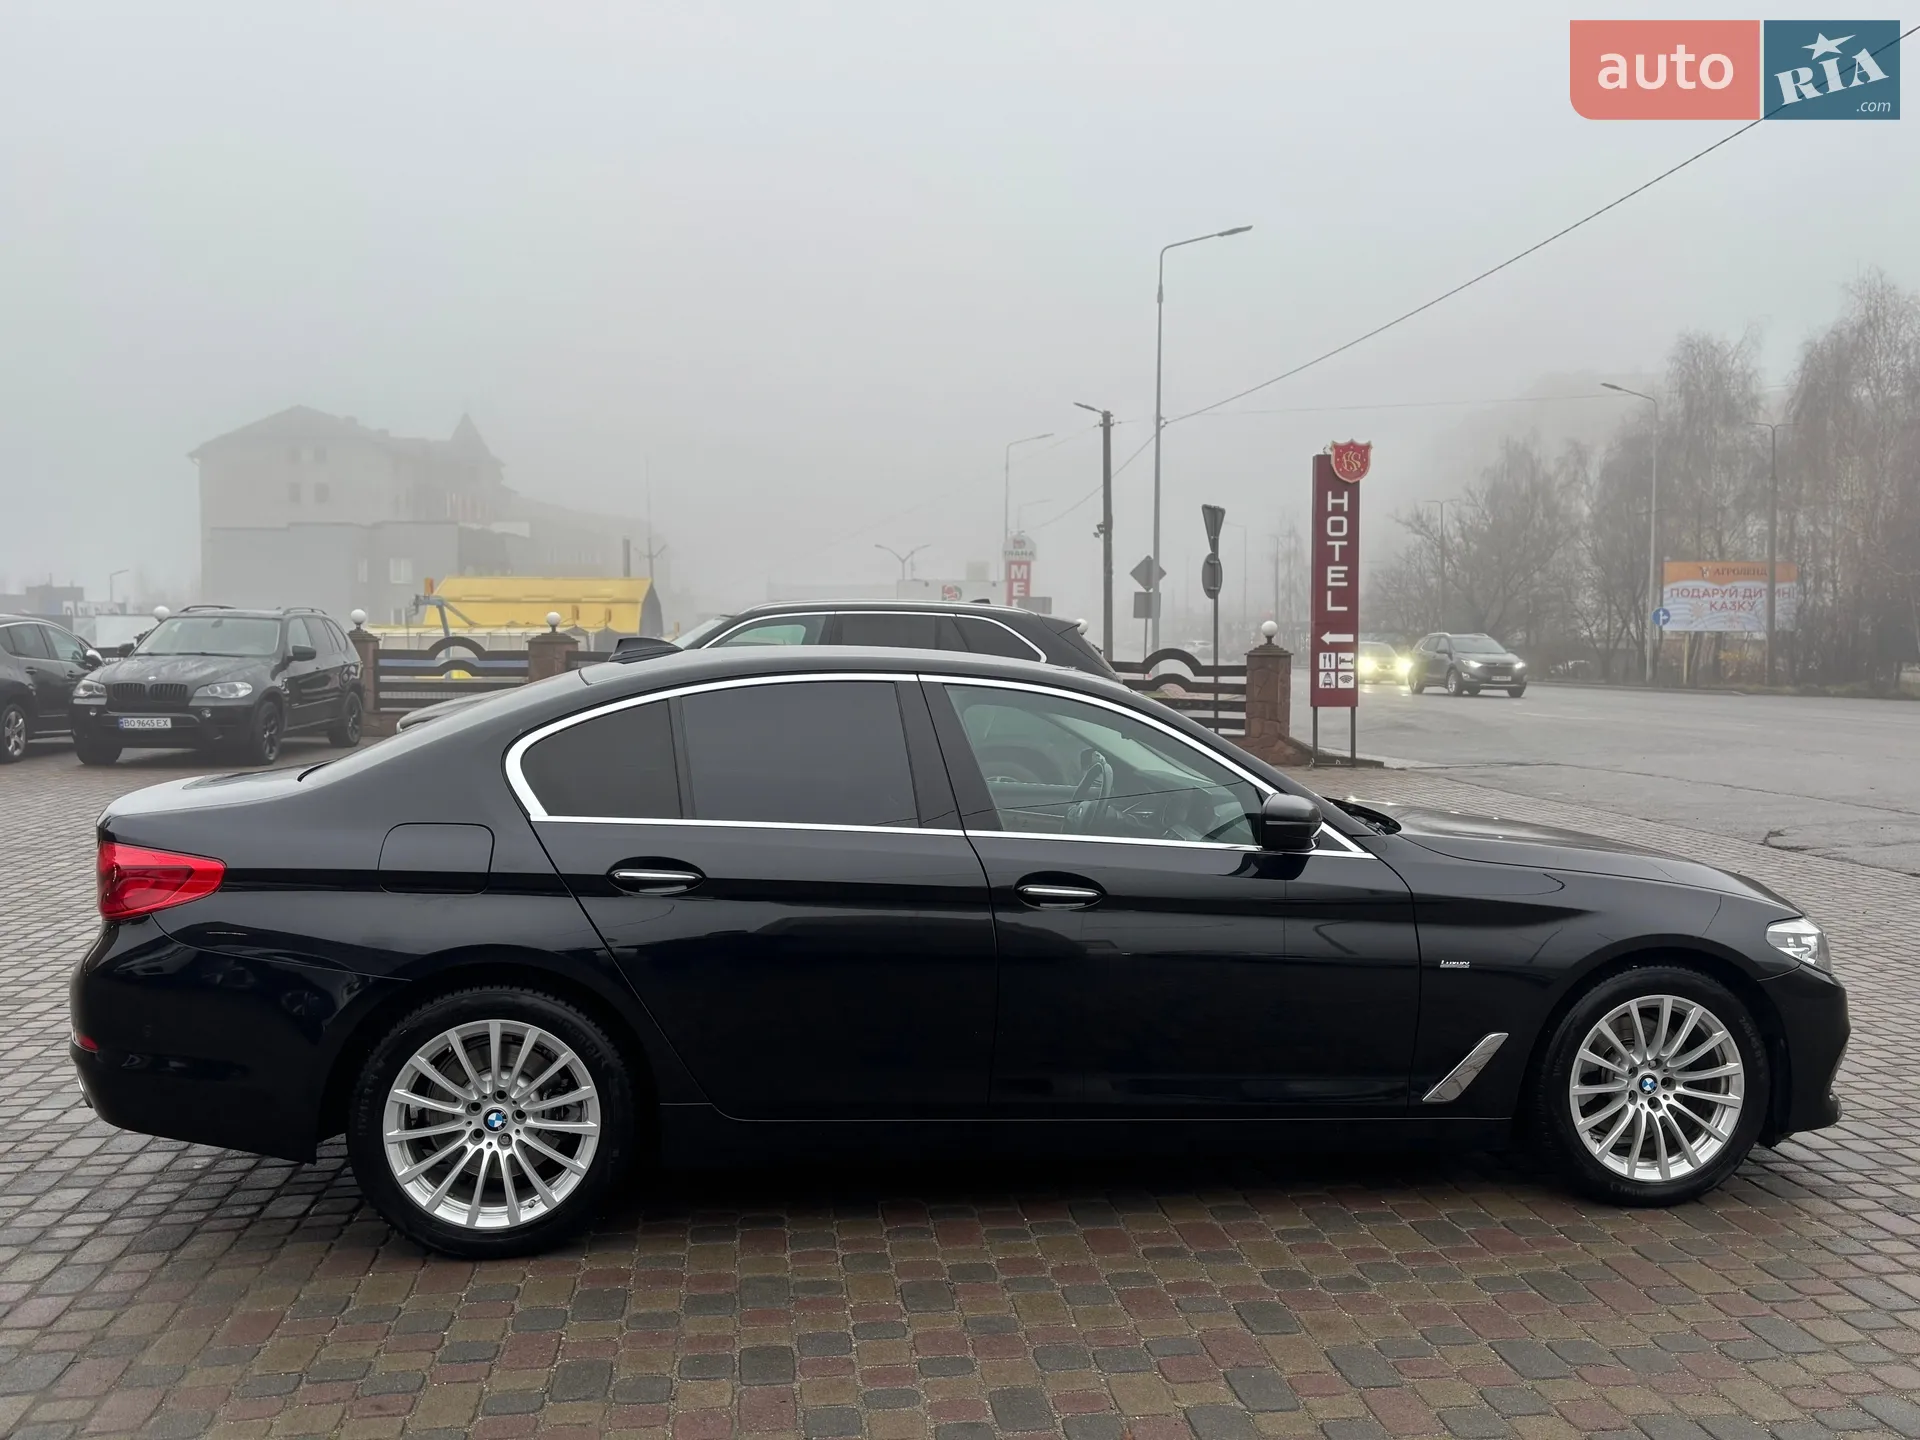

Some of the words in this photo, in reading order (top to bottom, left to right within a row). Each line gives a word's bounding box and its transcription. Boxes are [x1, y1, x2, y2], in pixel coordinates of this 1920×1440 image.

[1326, 491, 1349, 612] HOTEL
[1670, 586, 1738, 599] ПОДАРУЙ
[1709, 600, 1757, 611] КАЗКУ
[124, 719, 135, 727] BO
[136, 719, 155, 727] 9645
[156, 719, 168, 727] EX
